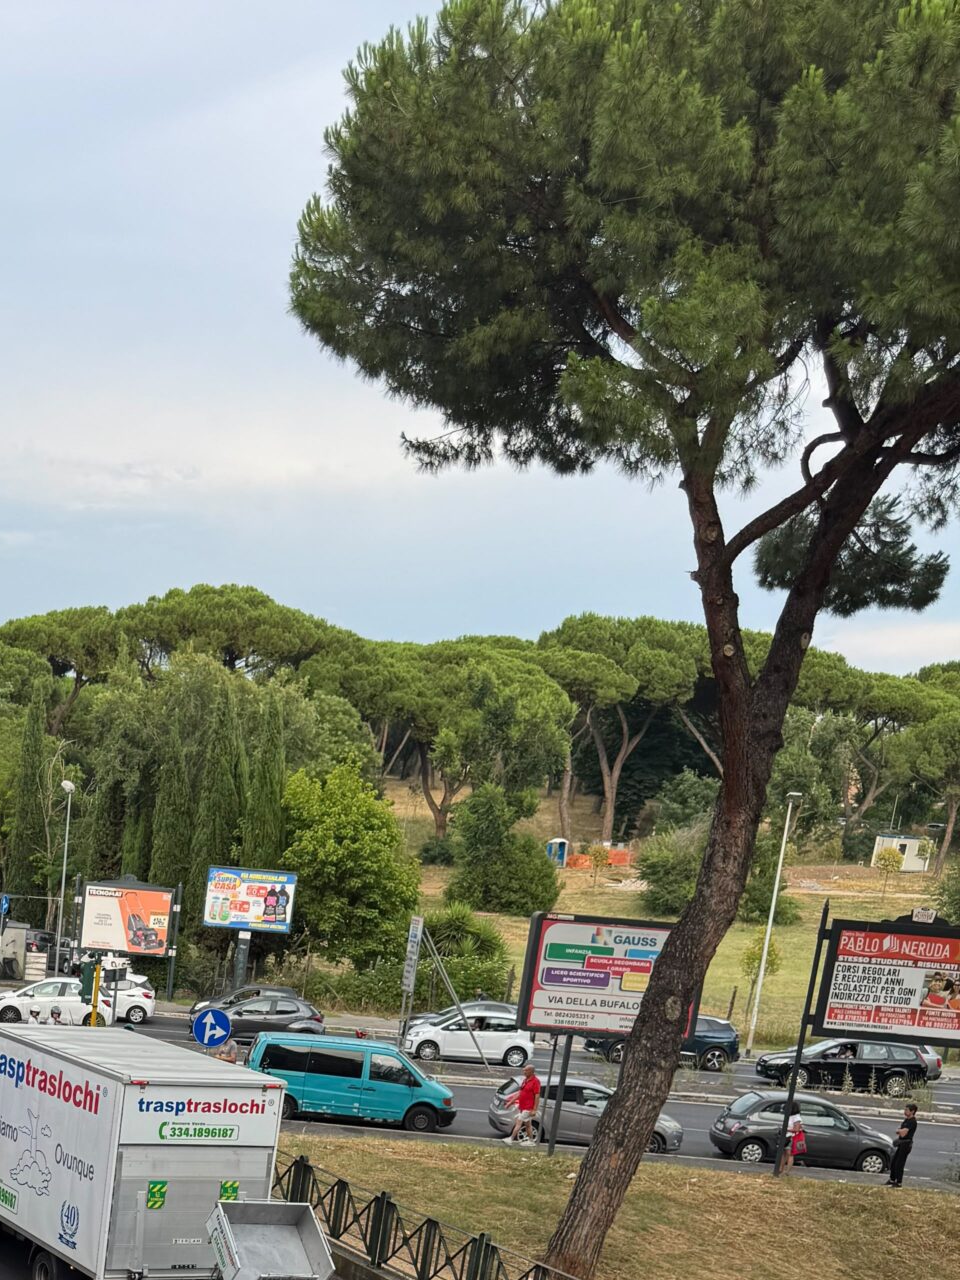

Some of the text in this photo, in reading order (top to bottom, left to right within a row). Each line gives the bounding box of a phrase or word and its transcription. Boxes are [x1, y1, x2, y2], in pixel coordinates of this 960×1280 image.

[214, 882, 237, 890] CASA
[89, 889, 123, 898] TECNOMAT
[613, 935, 657, 947] GAUSS
[840, 936, 950, 958] PABLO NERUDA
[838, 955, 958, 970] STESSO STUDENTE, RISULTATI
[569, 971, 604, 979] SCIENTIFICO
[836, 964, 901, 977] CORSI REGOLARI
[834, 973, 905, 987] E RECUPERO ANNI
[833, 982, 917, 998] SCOLASTICI PER OGNI
[548, 996, 640, 1010] VIA DELLA BUFALO
[831, 991, 911, 1006] INDIRIZZO DI STUDIO
[138, 1097, 266, 1116] trasptraslochi
[169, 1127, 235, 1138] 334.1896187
[54, 1143, 95, 1182] Ovunque
[64, 1204, 76, 1228] 40
